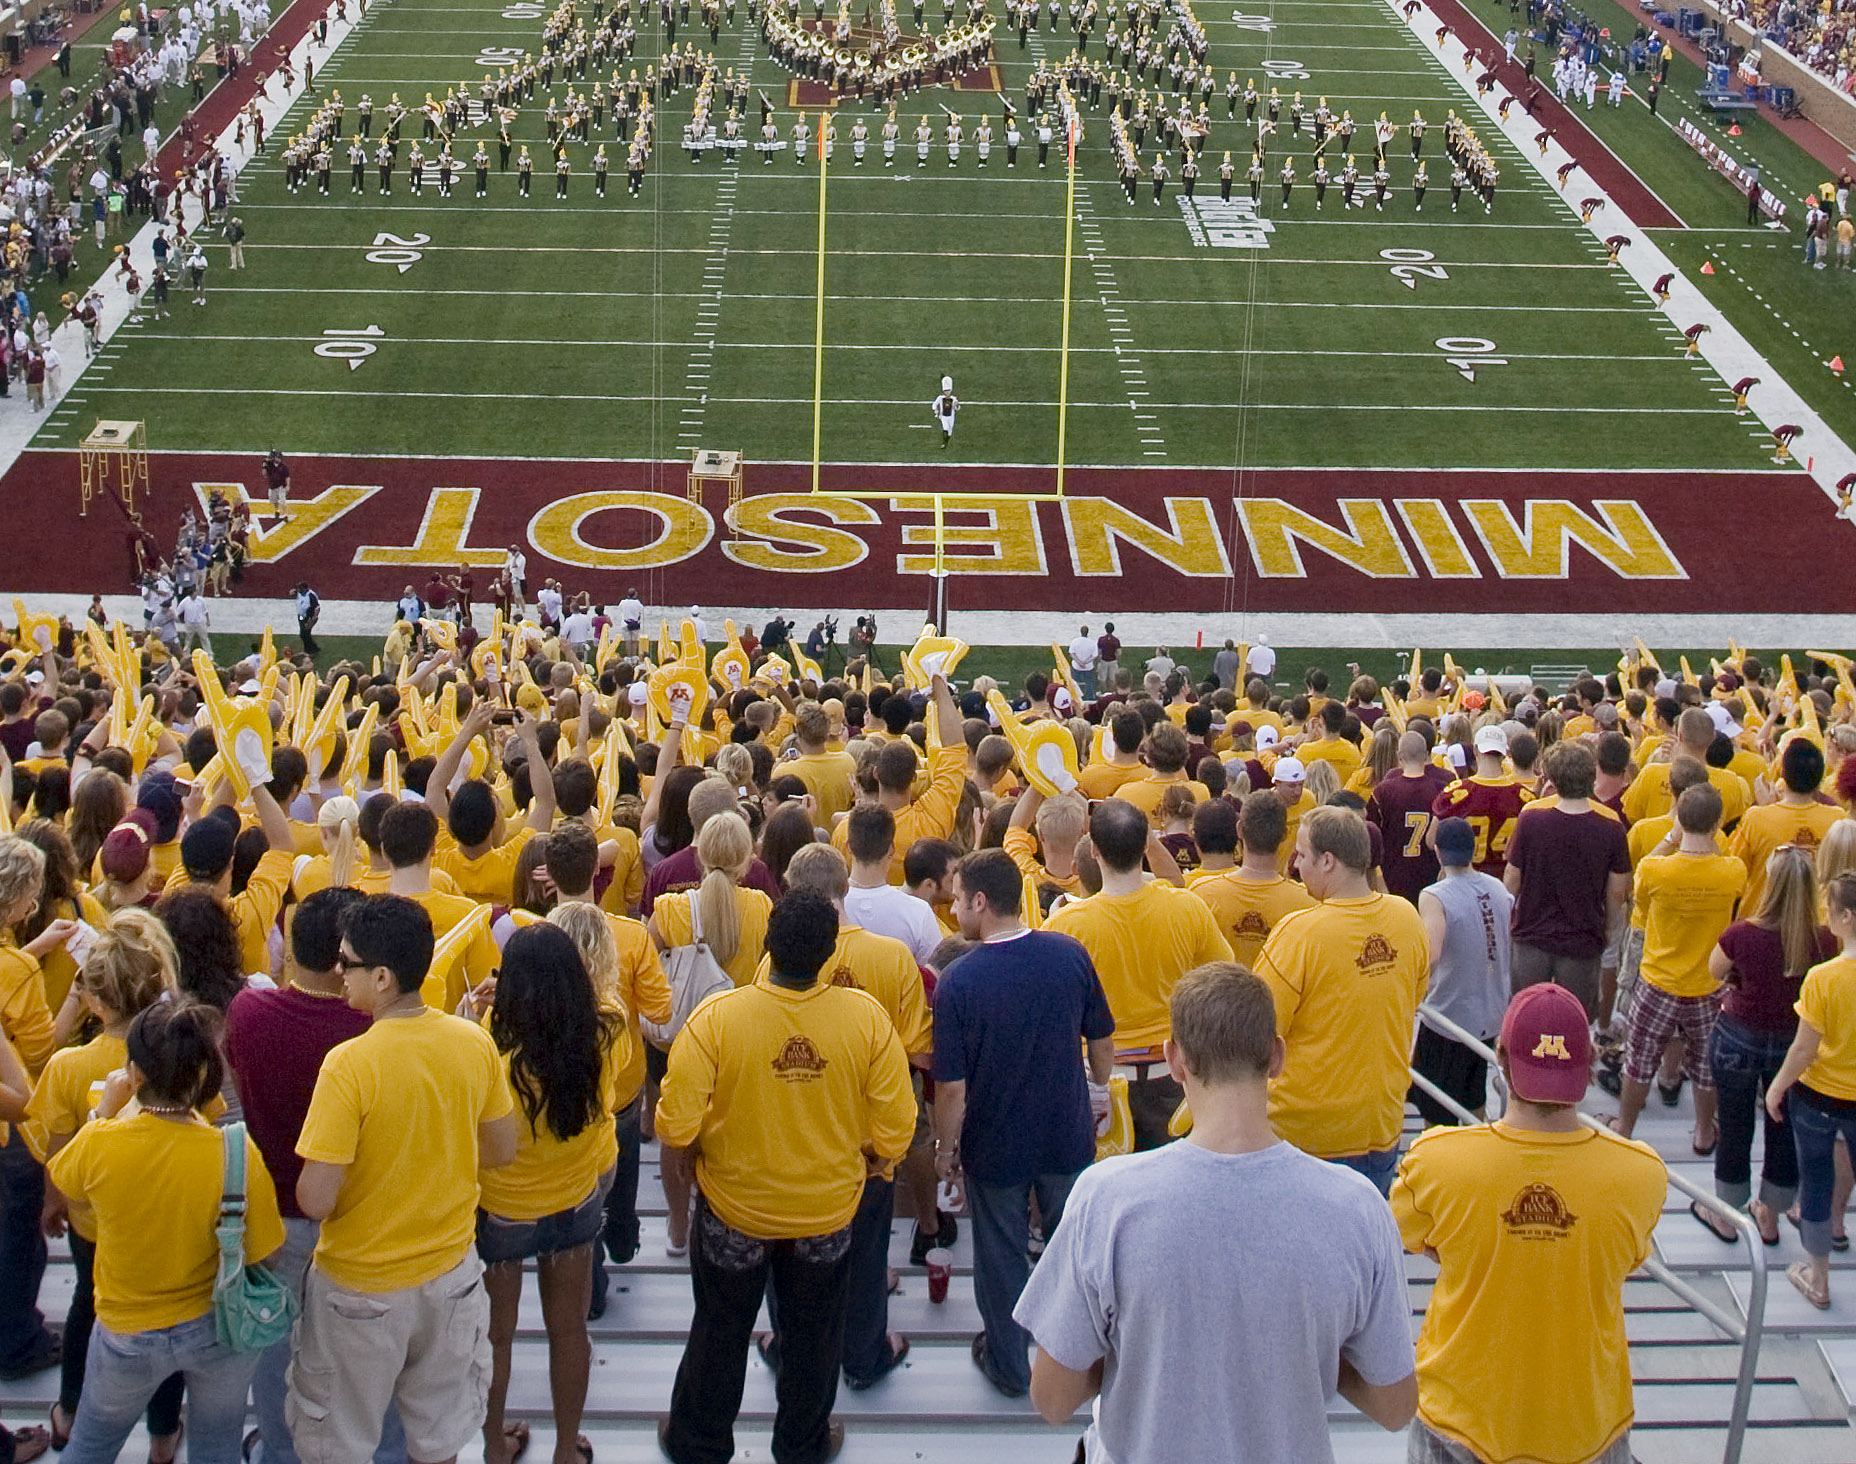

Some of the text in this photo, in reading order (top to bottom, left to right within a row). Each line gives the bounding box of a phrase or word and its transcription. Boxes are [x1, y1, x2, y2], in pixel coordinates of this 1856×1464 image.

[501, 2, 546, 20] 40
[1232, 14, 1277, 32] 40
[474, 47, 525, 66] 50
[1261, 60, 1312, 80] 50
[365, 232, 431, 260] 20
[1379, 248, 1448, 282] 20
[314, 325, 385, 360] 10
[1432, 336, 1508, 370] 10
[190, 480, 1691, 579] MINNESOTA
[1403, 811, 1431, 857] 7
[1532, 1033, 1572, 1060] M
